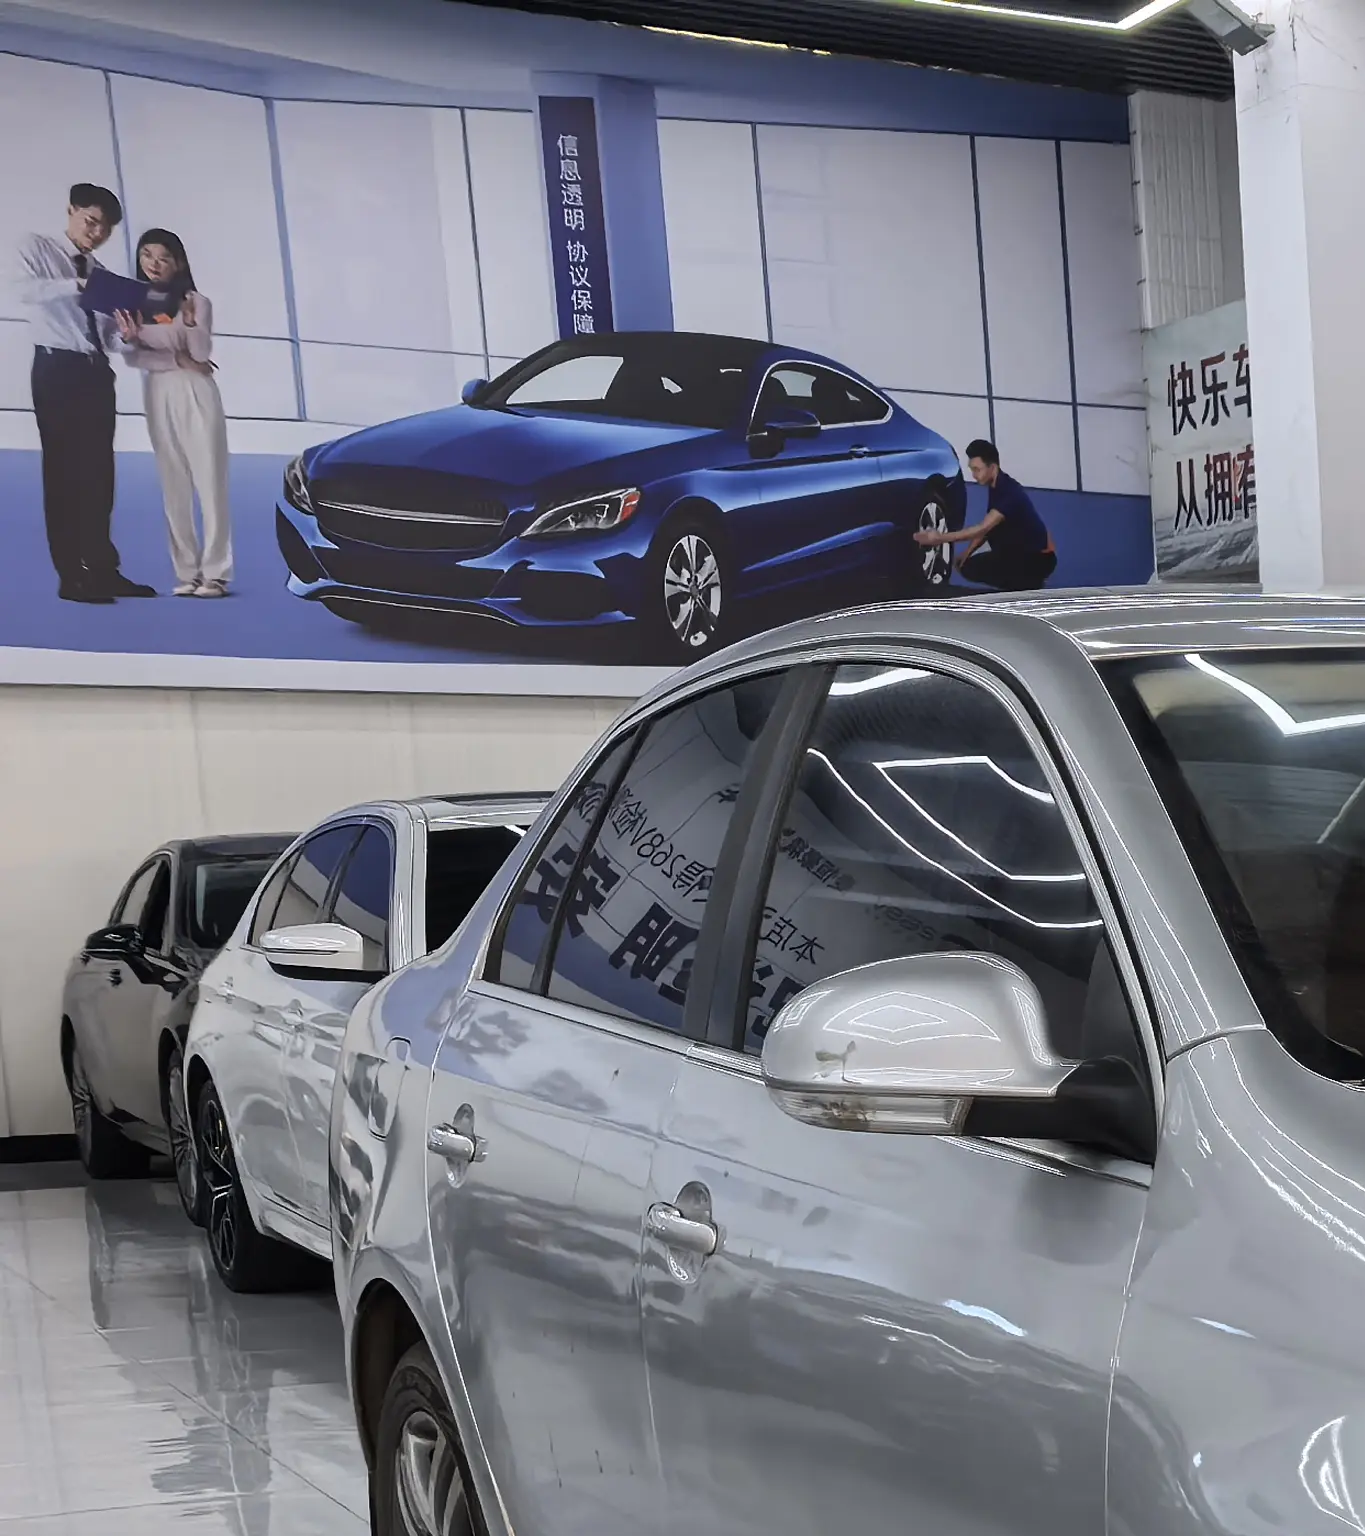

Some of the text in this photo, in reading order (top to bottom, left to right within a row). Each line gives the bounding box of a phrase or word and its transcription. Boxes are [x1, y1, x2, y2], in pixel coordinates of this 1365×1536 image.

[557, 133, 596, 334] 信息透明 协议保障
